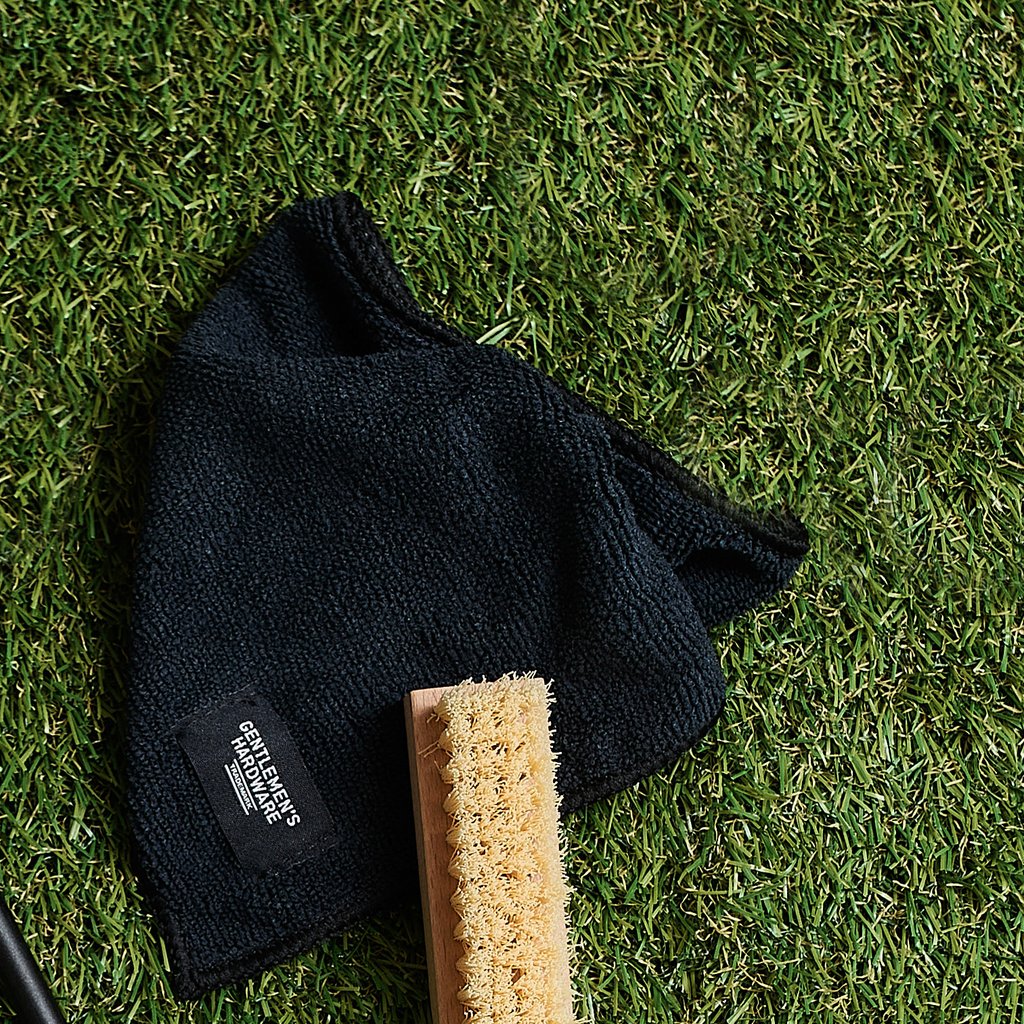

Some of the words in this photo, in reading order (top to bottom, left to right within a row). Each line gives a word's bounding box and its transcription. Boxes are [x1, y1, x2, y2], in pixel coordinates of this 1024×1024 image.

[229, 763, 253, 810] TRADEMARK
[230, 736, 282, 825] HARDWARE
[238, 720, 301, 827] GENTLEMEN'S
